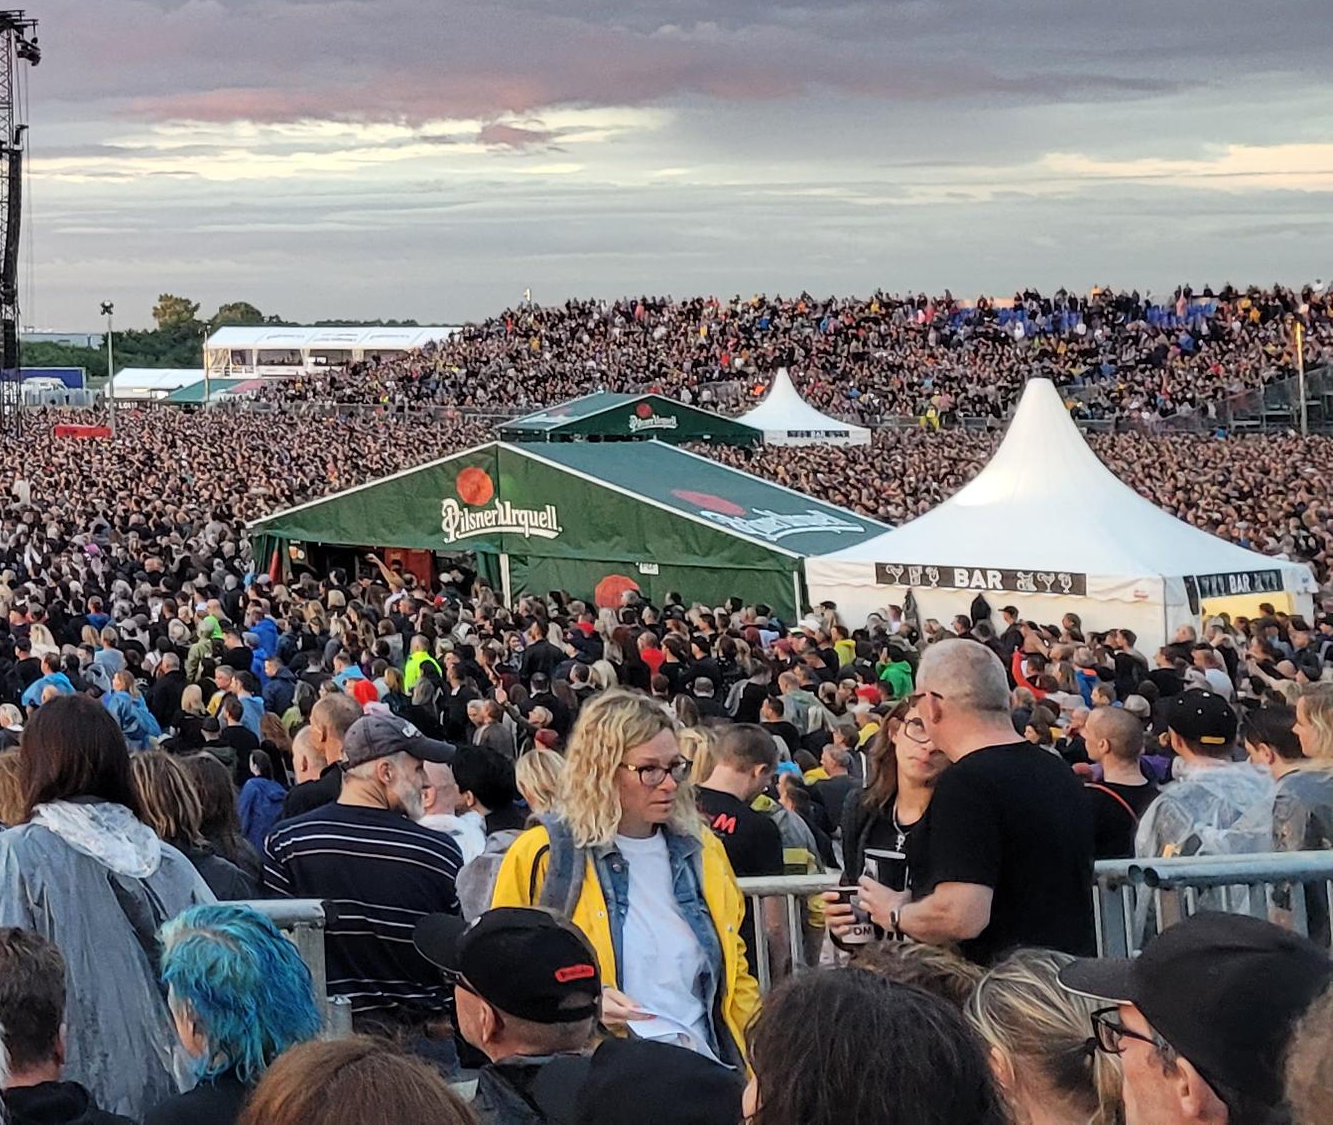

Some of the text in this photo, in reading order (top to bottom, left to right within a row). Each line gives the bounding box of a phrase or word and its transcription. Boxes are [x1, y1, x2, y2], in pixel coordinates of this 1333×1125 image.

[442, 498, 499, 544] Pilsner
[954, 567, 1004, 590] BAR
[1228, 573, 1252, 594] BAR
[707, 813, 737, 834] M
